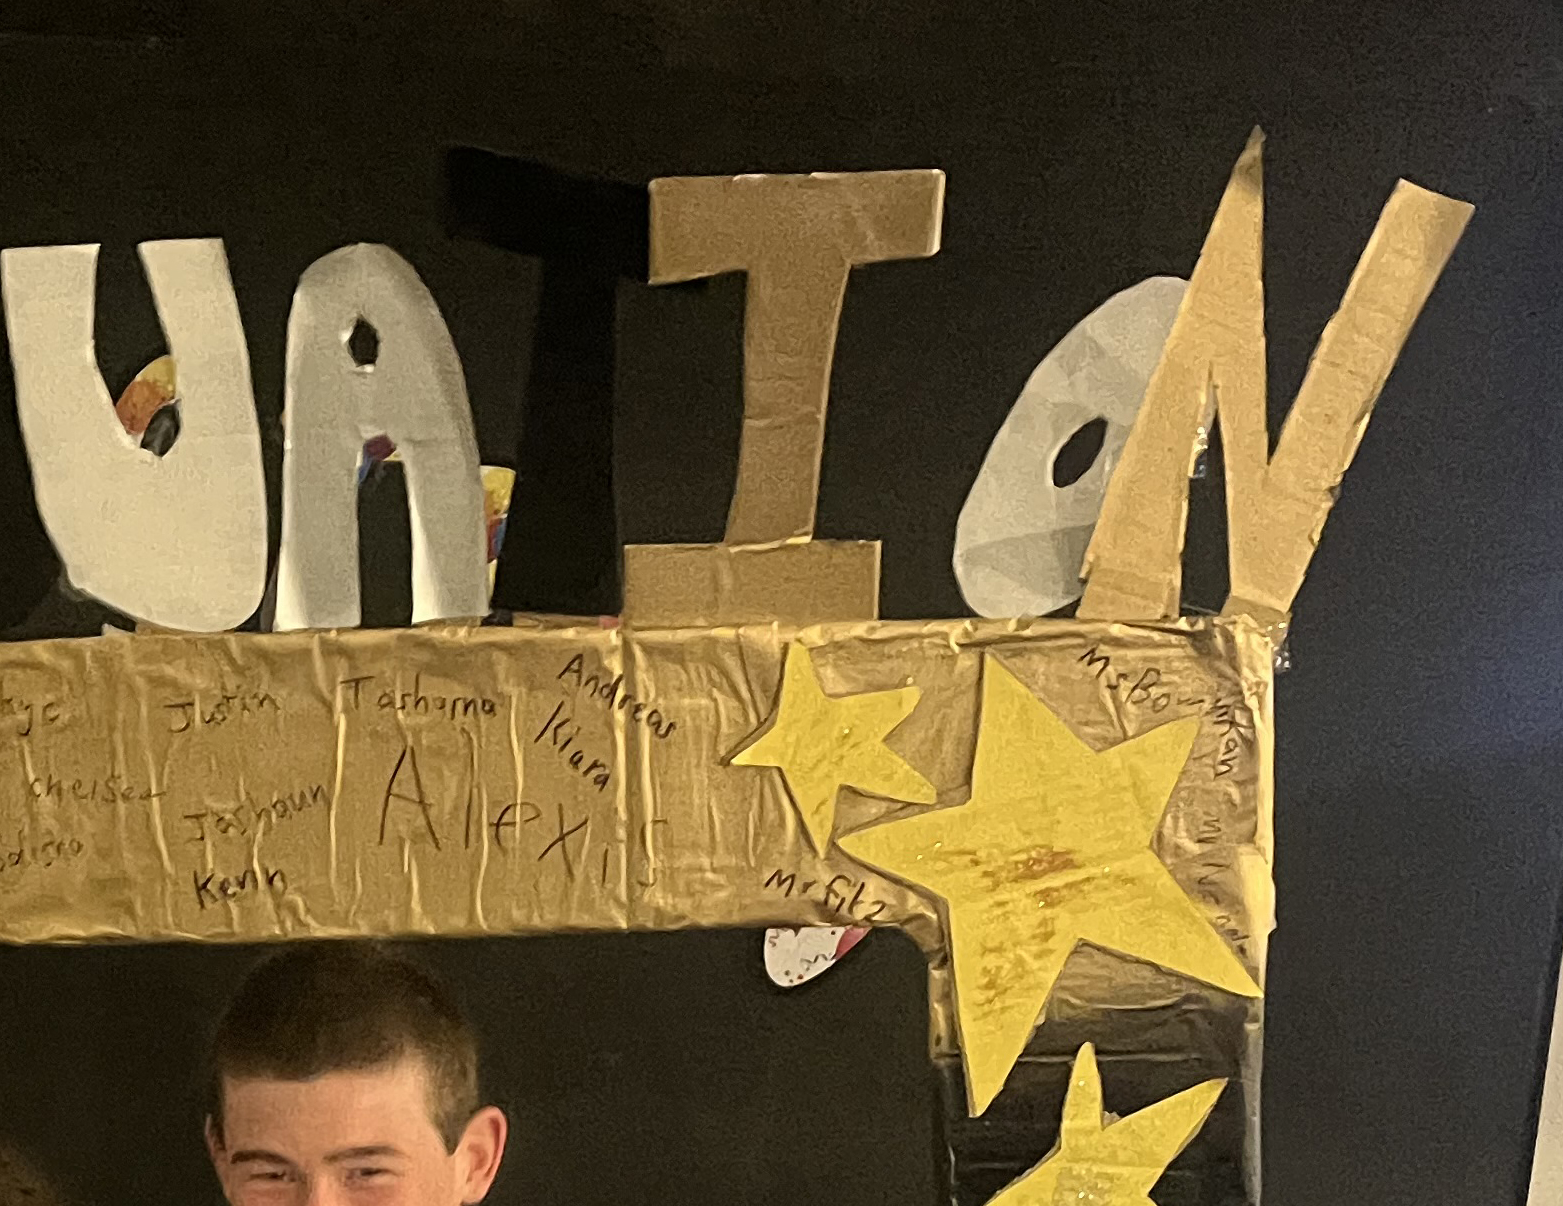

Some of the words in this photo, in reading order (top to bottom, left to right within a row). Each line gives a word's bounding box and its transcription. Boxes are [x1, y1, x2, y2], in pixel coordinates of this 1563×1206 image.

[163, 686, 281, 735] Justin
[555, 651, 679, 743] Andreas
[533, 700, 615, 793] Kiara
[377, 724, 670, 890] Alexis
[192, 862, 288, 911] Kevin
